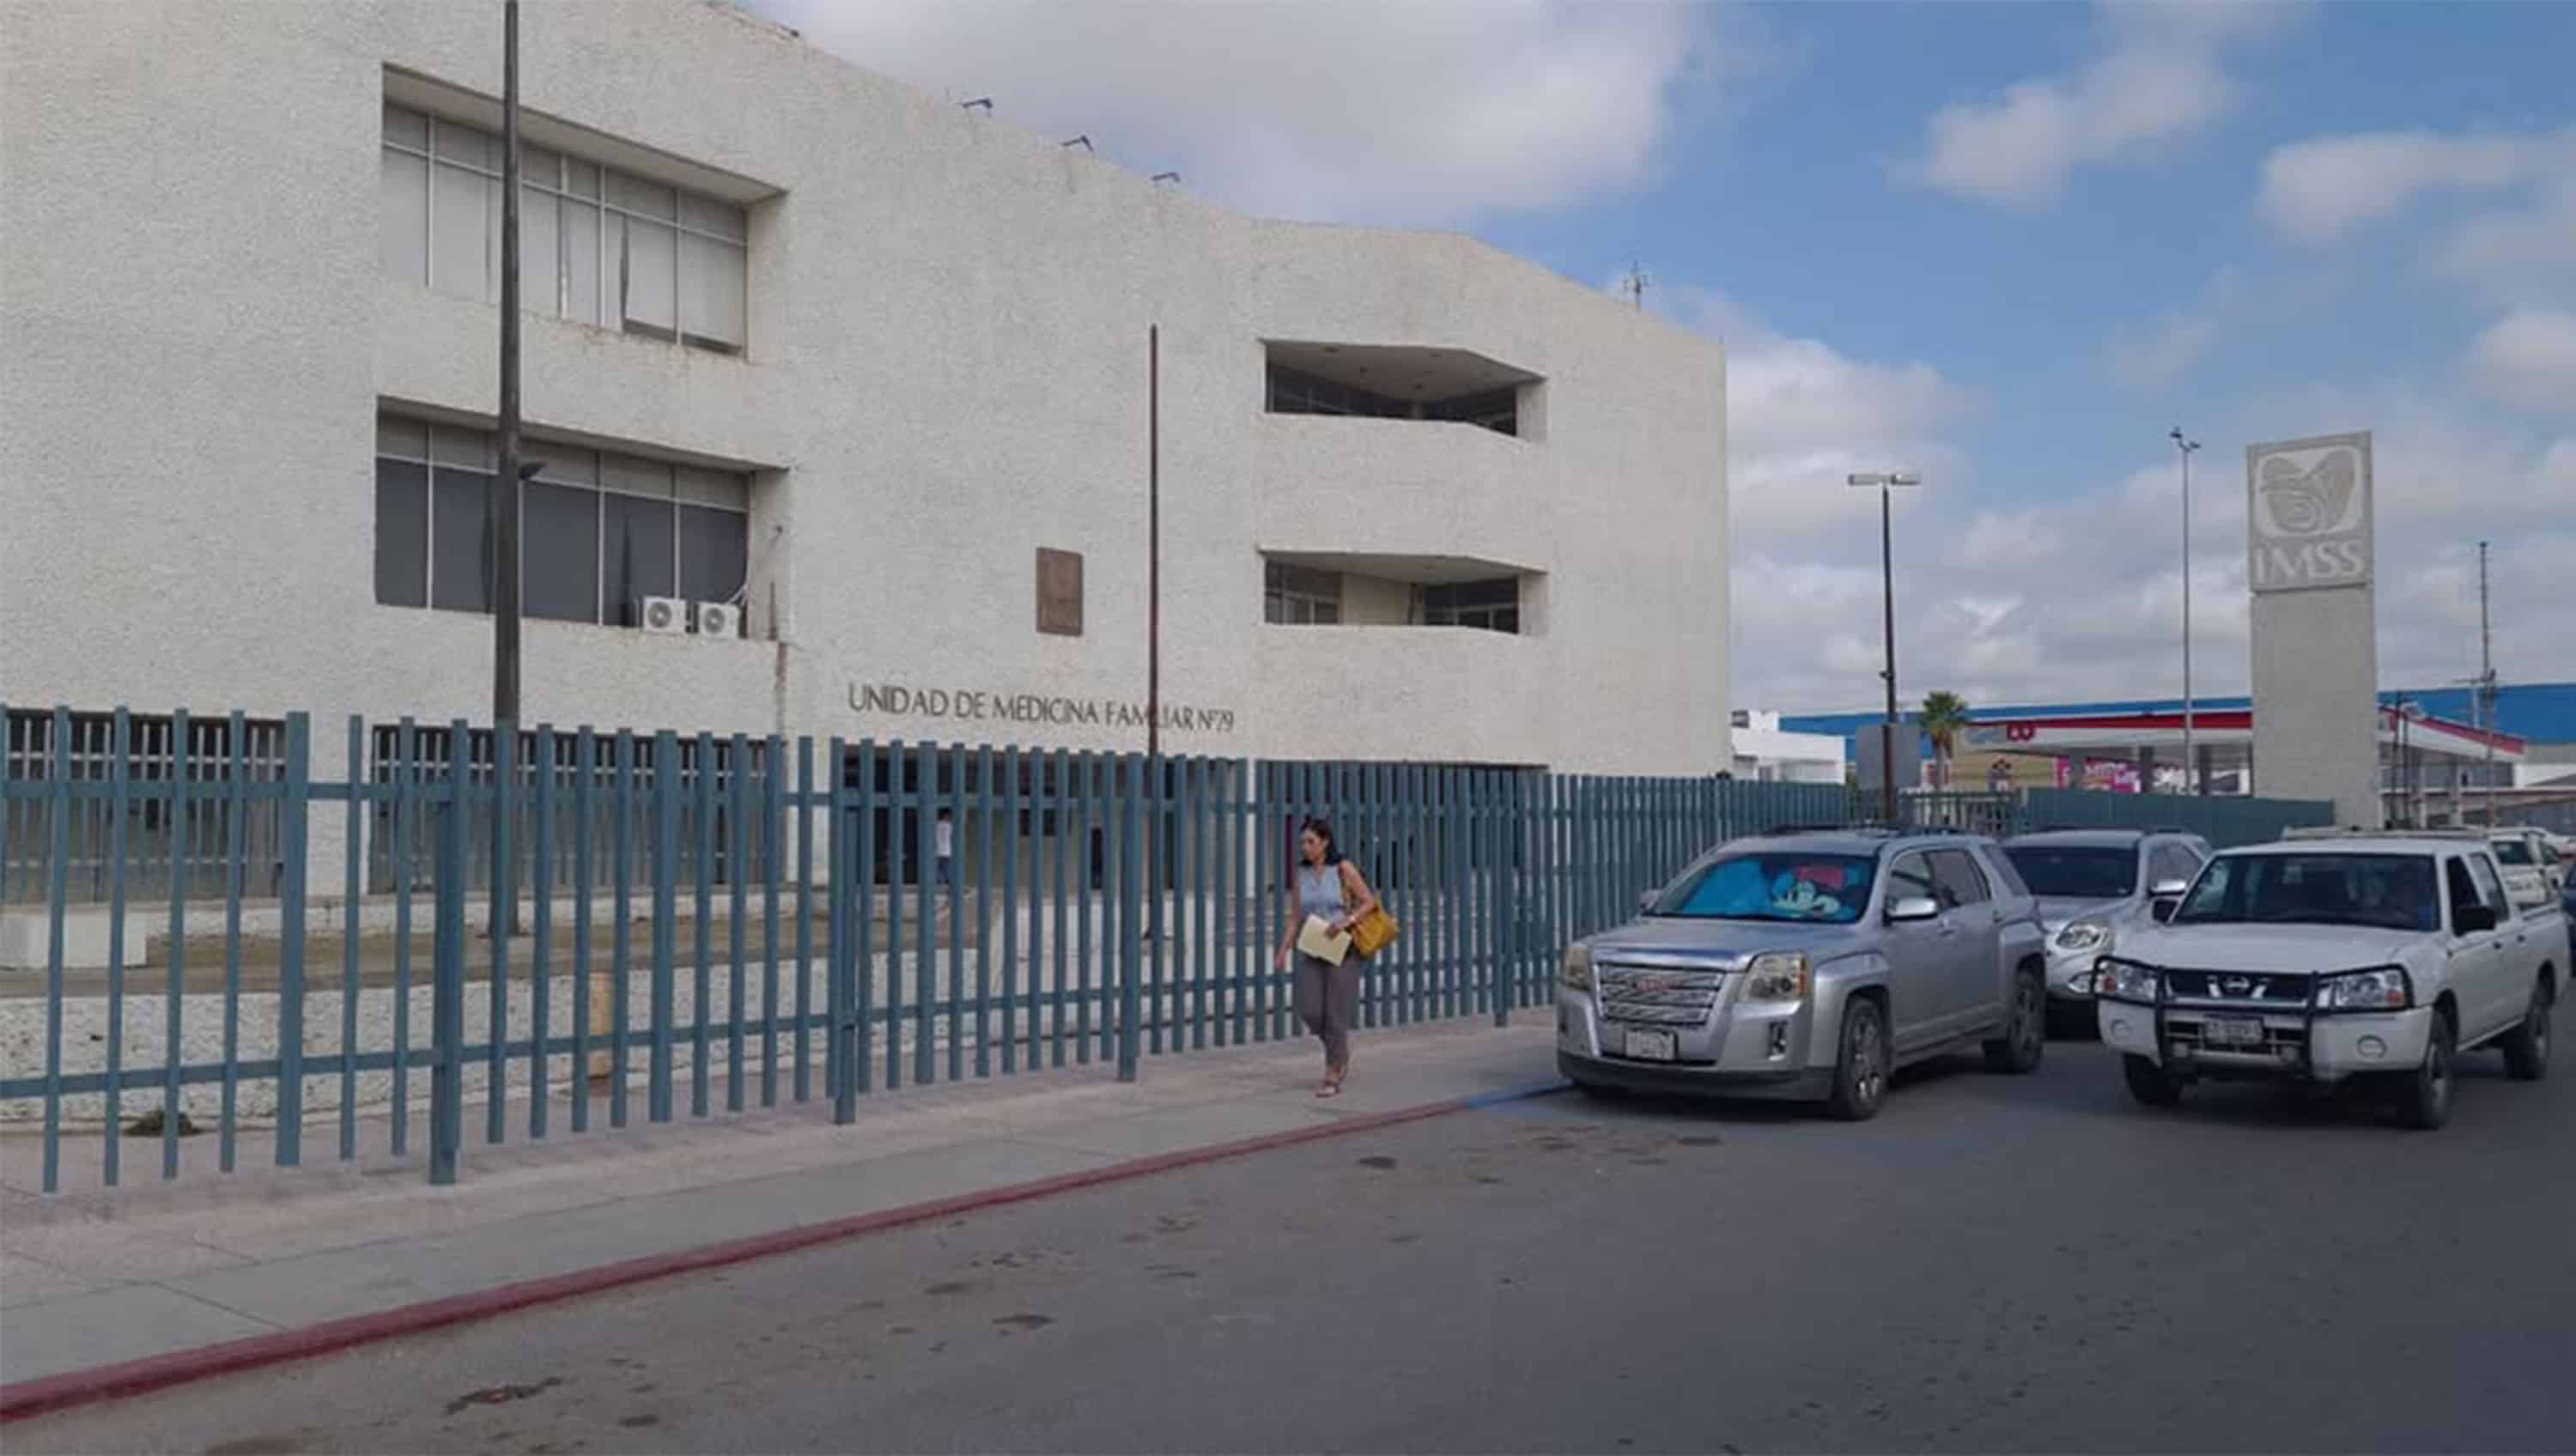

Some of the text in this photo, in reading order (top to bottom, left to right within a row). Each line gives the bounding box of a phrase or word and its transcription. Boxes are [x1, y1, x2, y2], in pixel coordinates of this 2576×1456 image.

[2254, 541, 2365, 583] IMSS
[848, 682, 950, 716] UNIDAD
[955, 689, 987, 719] DE
[992, 693, 1099, 724] MEDICINA
[1106, 701, 1194, 731] FAMIAR
